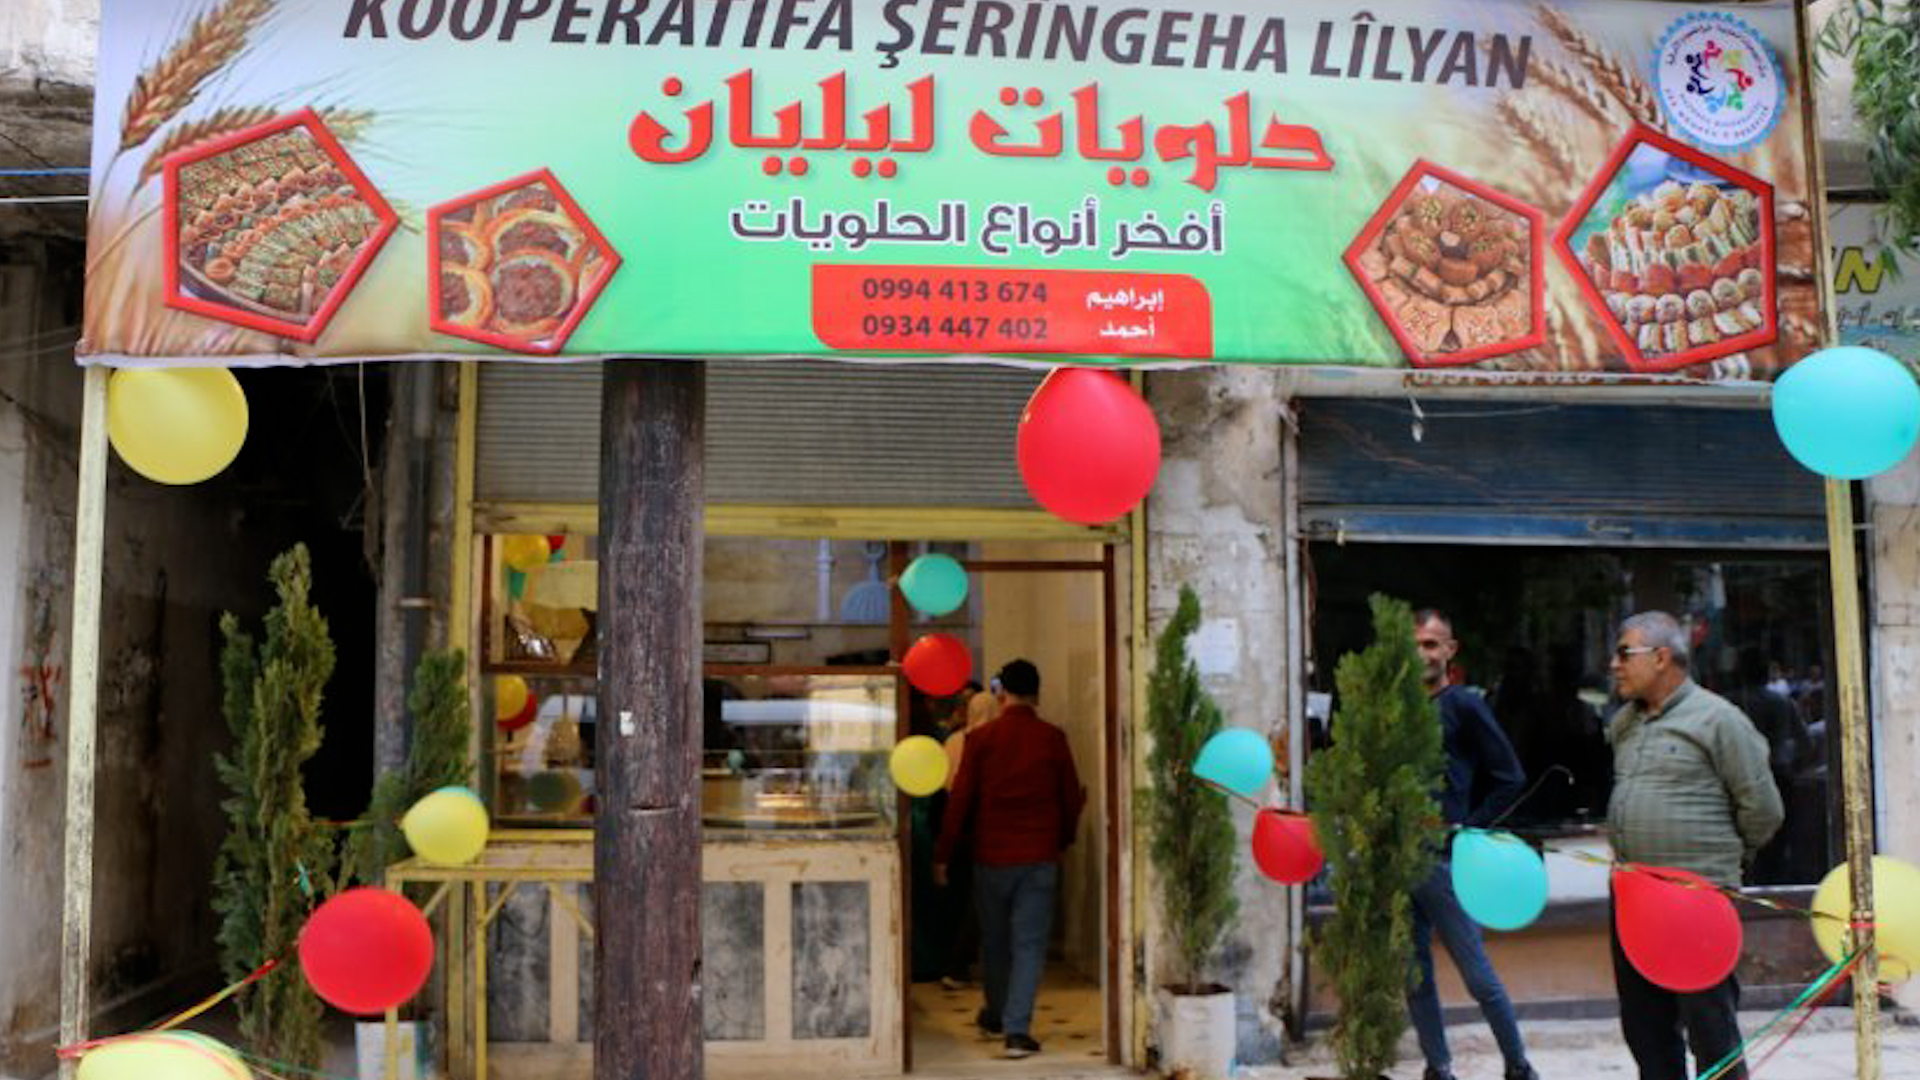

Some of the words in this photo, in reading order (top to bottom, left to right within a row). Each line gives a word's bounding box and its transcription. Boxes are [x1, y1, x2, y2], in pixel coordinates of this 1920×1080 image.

[1310, 10, 1532, 89] LÎLYAN
[628, 67, 935, 179] ليليان
[969, 81, 1335, 193] حلويات
[732, 198, 966, 249] الحلويات
[981, 197, 1097, 254] أنواع
[1111, 203, 1224, 257] أفخر
[862, 278, 932, 301] 0994
[938, 279, 989, 303] 413
[999, 281, 1048, 304] 674
[862, 316, 932, 338] 0934
[938, 317, 990, 339] 447
[999, 318, 1048, 340] 402
[1099, 316, 1156, 338] أحمد
